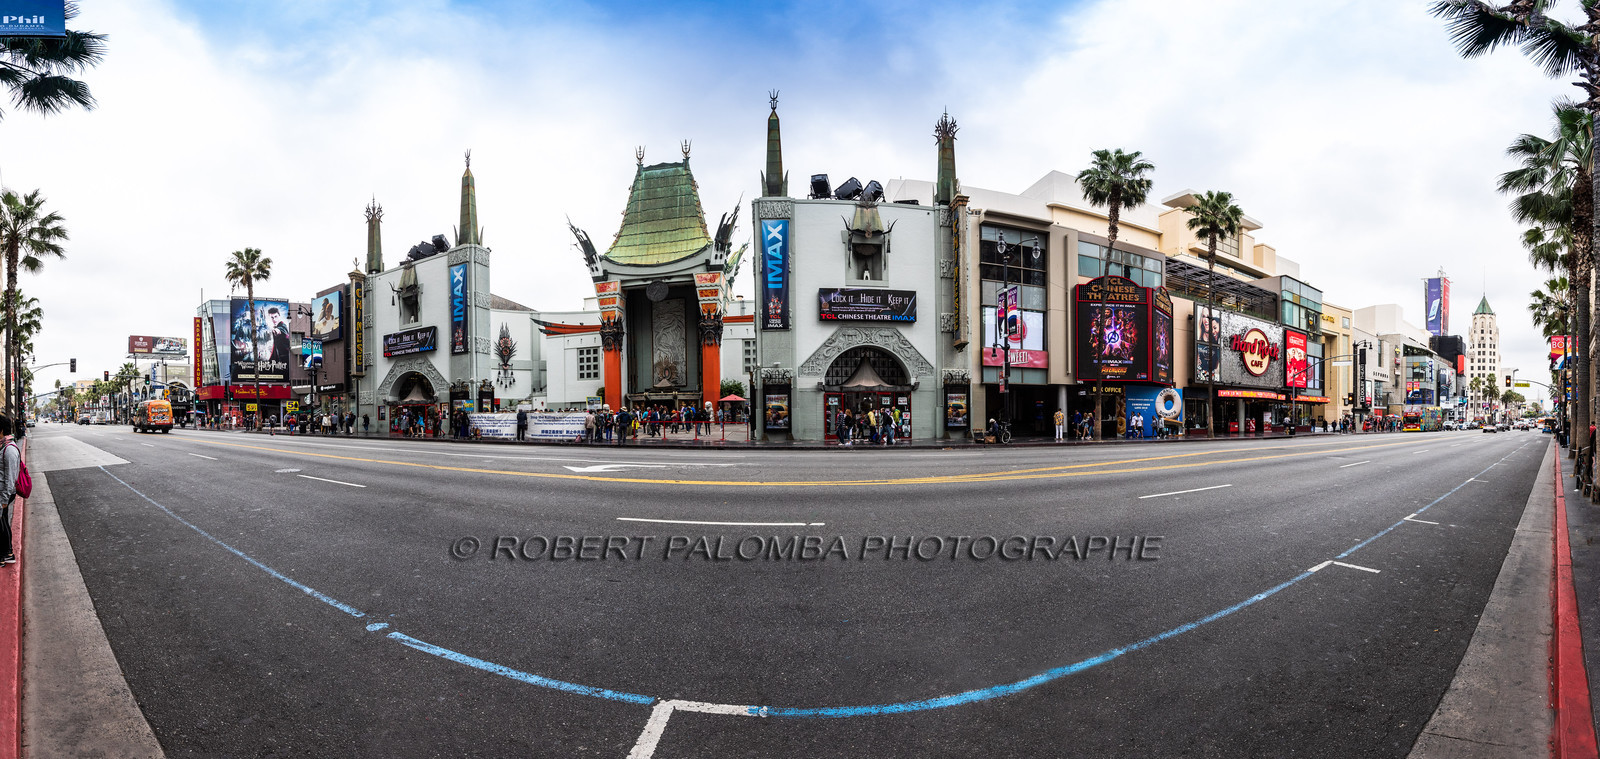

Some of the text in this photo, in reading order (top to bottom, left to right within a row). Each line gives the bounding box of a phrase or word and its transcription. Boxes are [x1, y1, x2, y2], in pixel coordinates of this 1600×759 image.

[3, 15, 45, 24] Phil
[768, 223, 783, 289] IMAX
[453, 268, 464, 322] IMAX
[861, 294, 875, 304] HIDE
[876, 295, 882, 304] IT
[887, 294, 903, 305] KEEP
[1087, 292, 1140, 302] THATRES
[302, 342, 322, 351] BOWL
[1232, 334, 1258, 354] Hard
[1257, 340, 1280, 361] Rock
[257, 360, 272, 372] Harry
[271, 359, 288, 373] Potter
[1250, 359, 1264, 369] CAFE
[1104, 386, 1122, 394] OFFICE
[177, 395, 187, 403] LA
